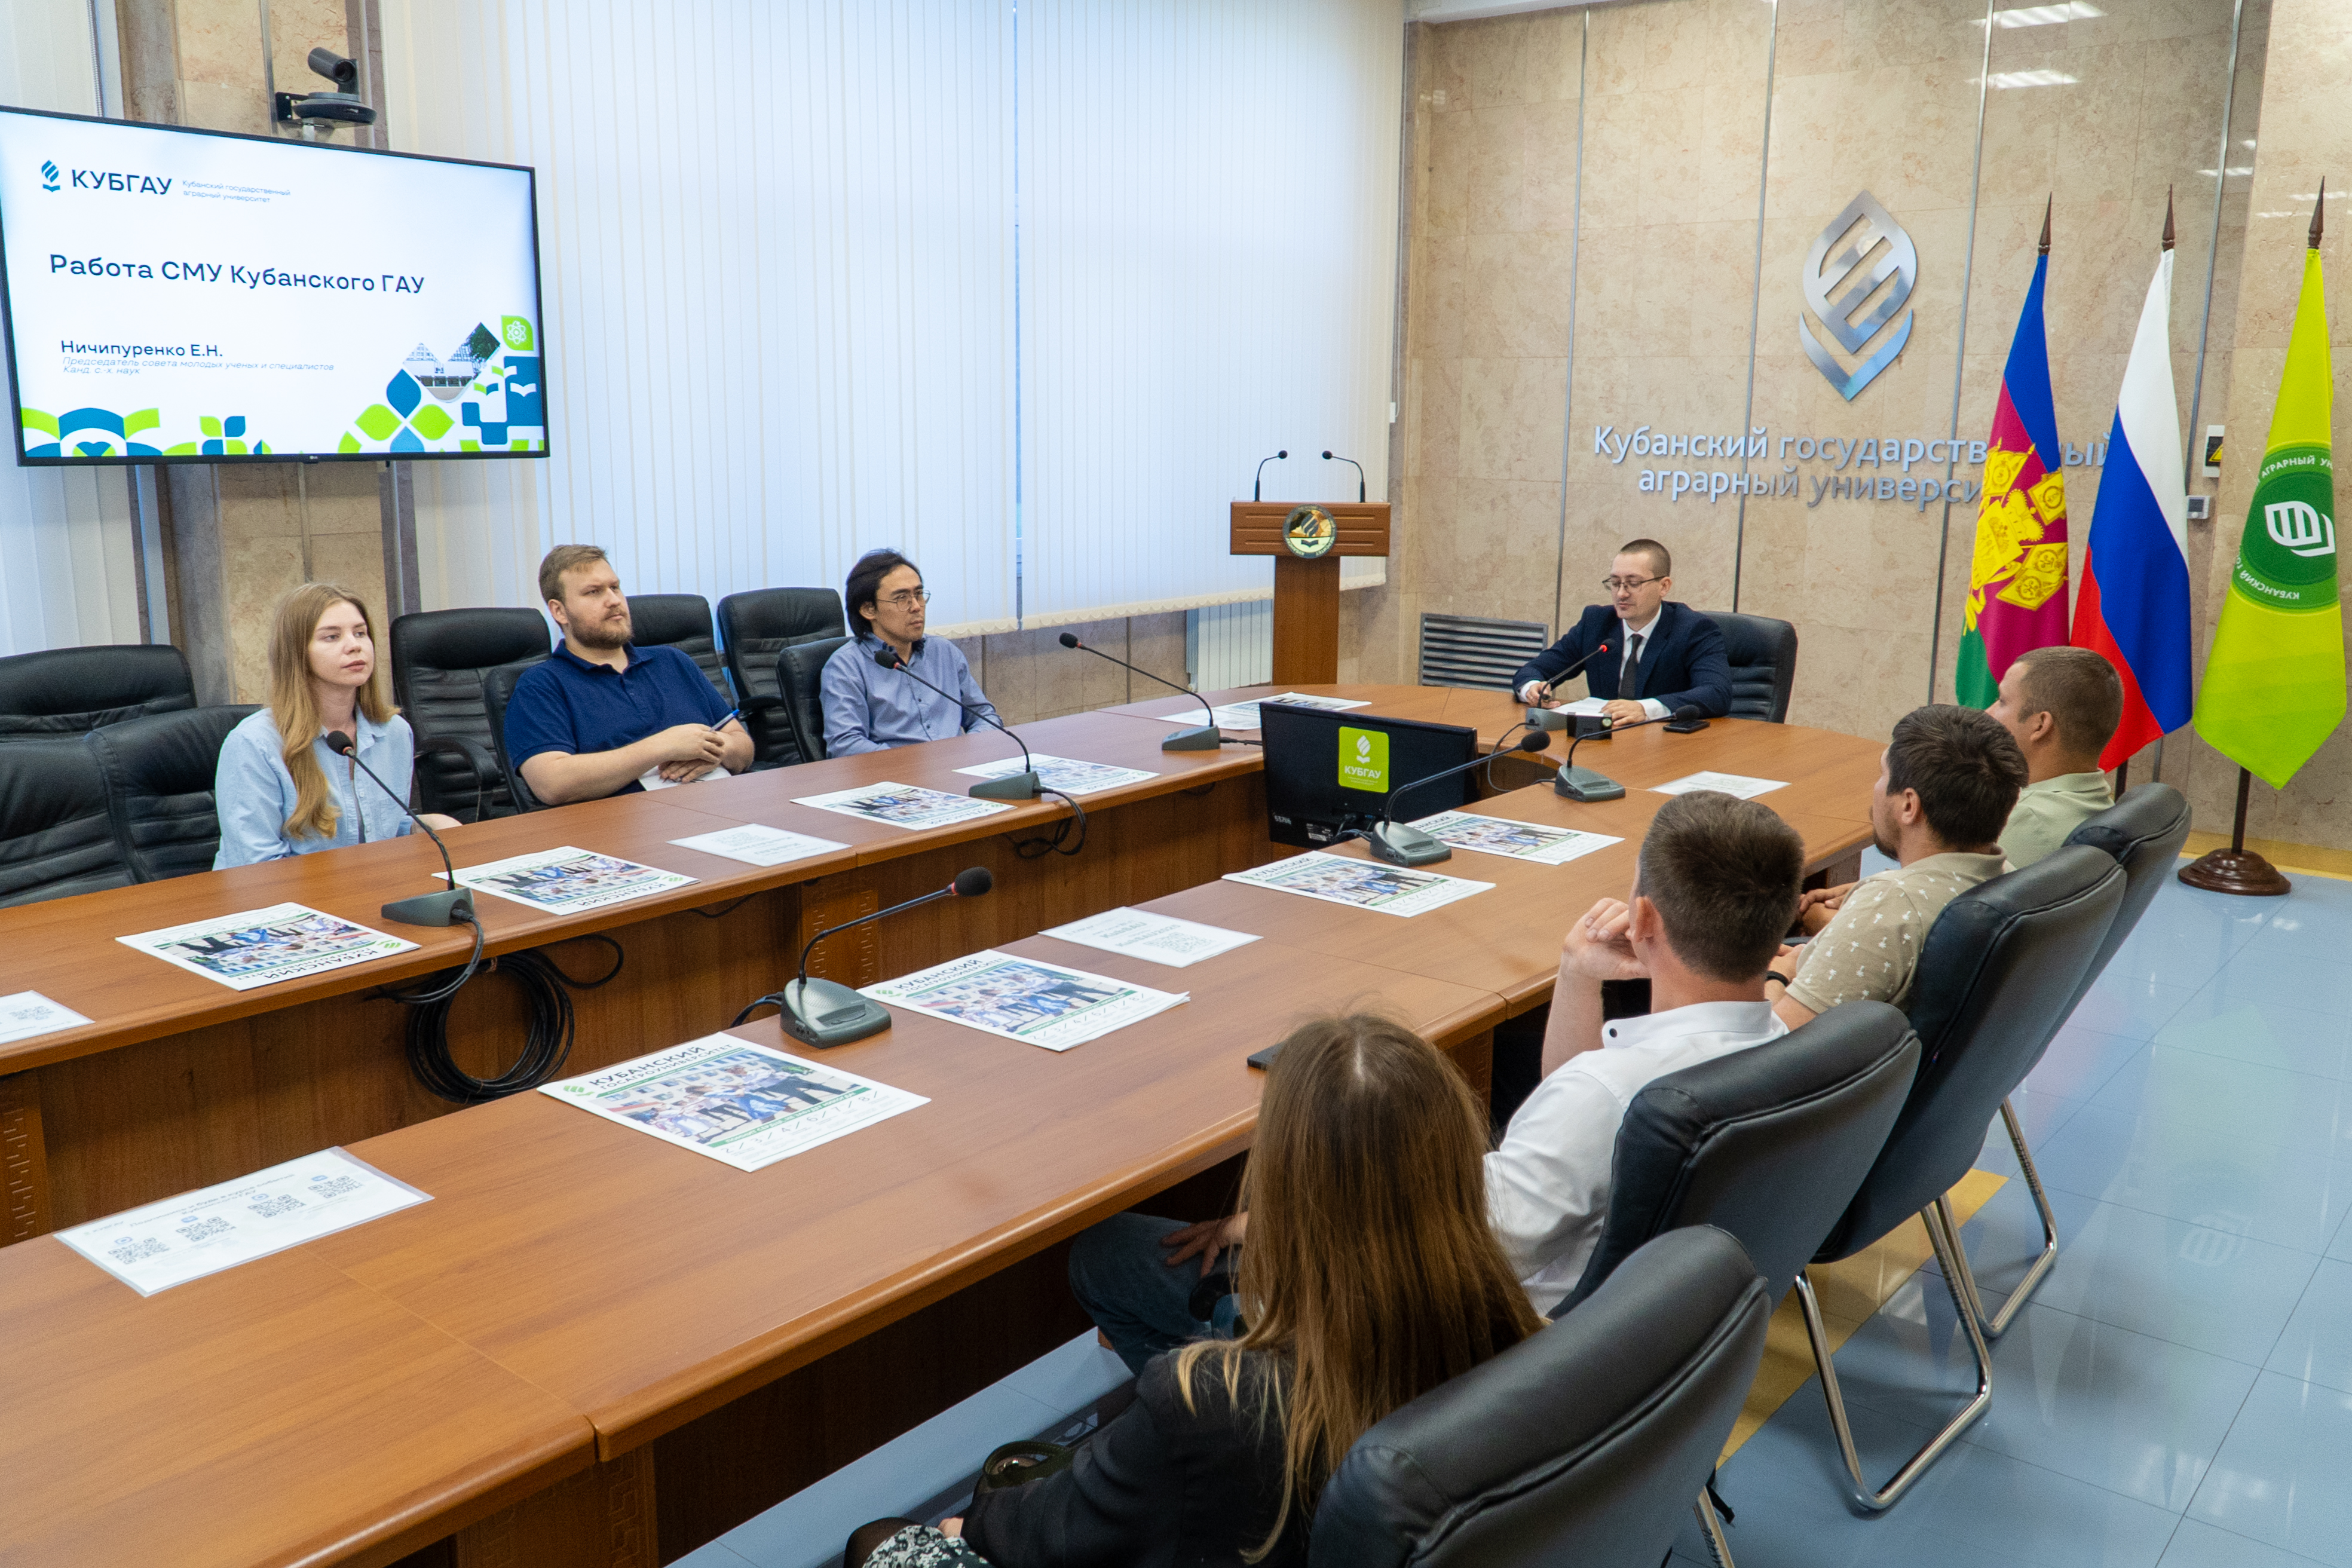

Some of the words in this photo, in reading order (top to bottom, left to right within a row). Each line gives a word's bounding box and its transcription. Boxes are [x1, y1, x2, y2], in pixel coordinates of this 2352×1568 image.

[72, 169, 173, 195] КУБГАУ
[182, 180, 223, 189] Кубанский
[225, 185, 291, 195] государственный
[223, 194, 271, 203] университет
[50, 254, 154, 278] Работа
[161, 261, 222, 281] СМУ
[231, 265, 375, 291] Кубанского
[382, 274, 425, 294] ГАУ
[61, 341, 185, 357] Ничипуренко
[191, 344, 223, 356] Е.Н.
[63, 357, 139, 366] Председатель
[269, 362, 334, 371] специалистов
[63, 366, 91, 374] Канд.
[116, 367, 140, 375] наук
[1594, 424, 1768, 464] Кубанский
[1779, 431, 2111, 472] государствы
[2261, 455, 2316, 478] АГРАРНЫЙ
[1639, 466, 1799, 501] аграрный
[1807, 475, 1982, 512] универси
[2240, 569, 2300, 599] КУБАНСКИЙ
[1344, 765, 1382, 779] КУБГАУ
[577, 883, 666, 906] КУБАНСКИЙ
[265, 949, 379, 979] КУБАНСКИЙ
[894, 958, 983, 990] КУБАНСКИЙ
[589, 1046, 706, 1086] КУБАНСКИЙ
[600, 1044, 734, 1090] ГОСАГРОУНИВЕРСИТЕТ
